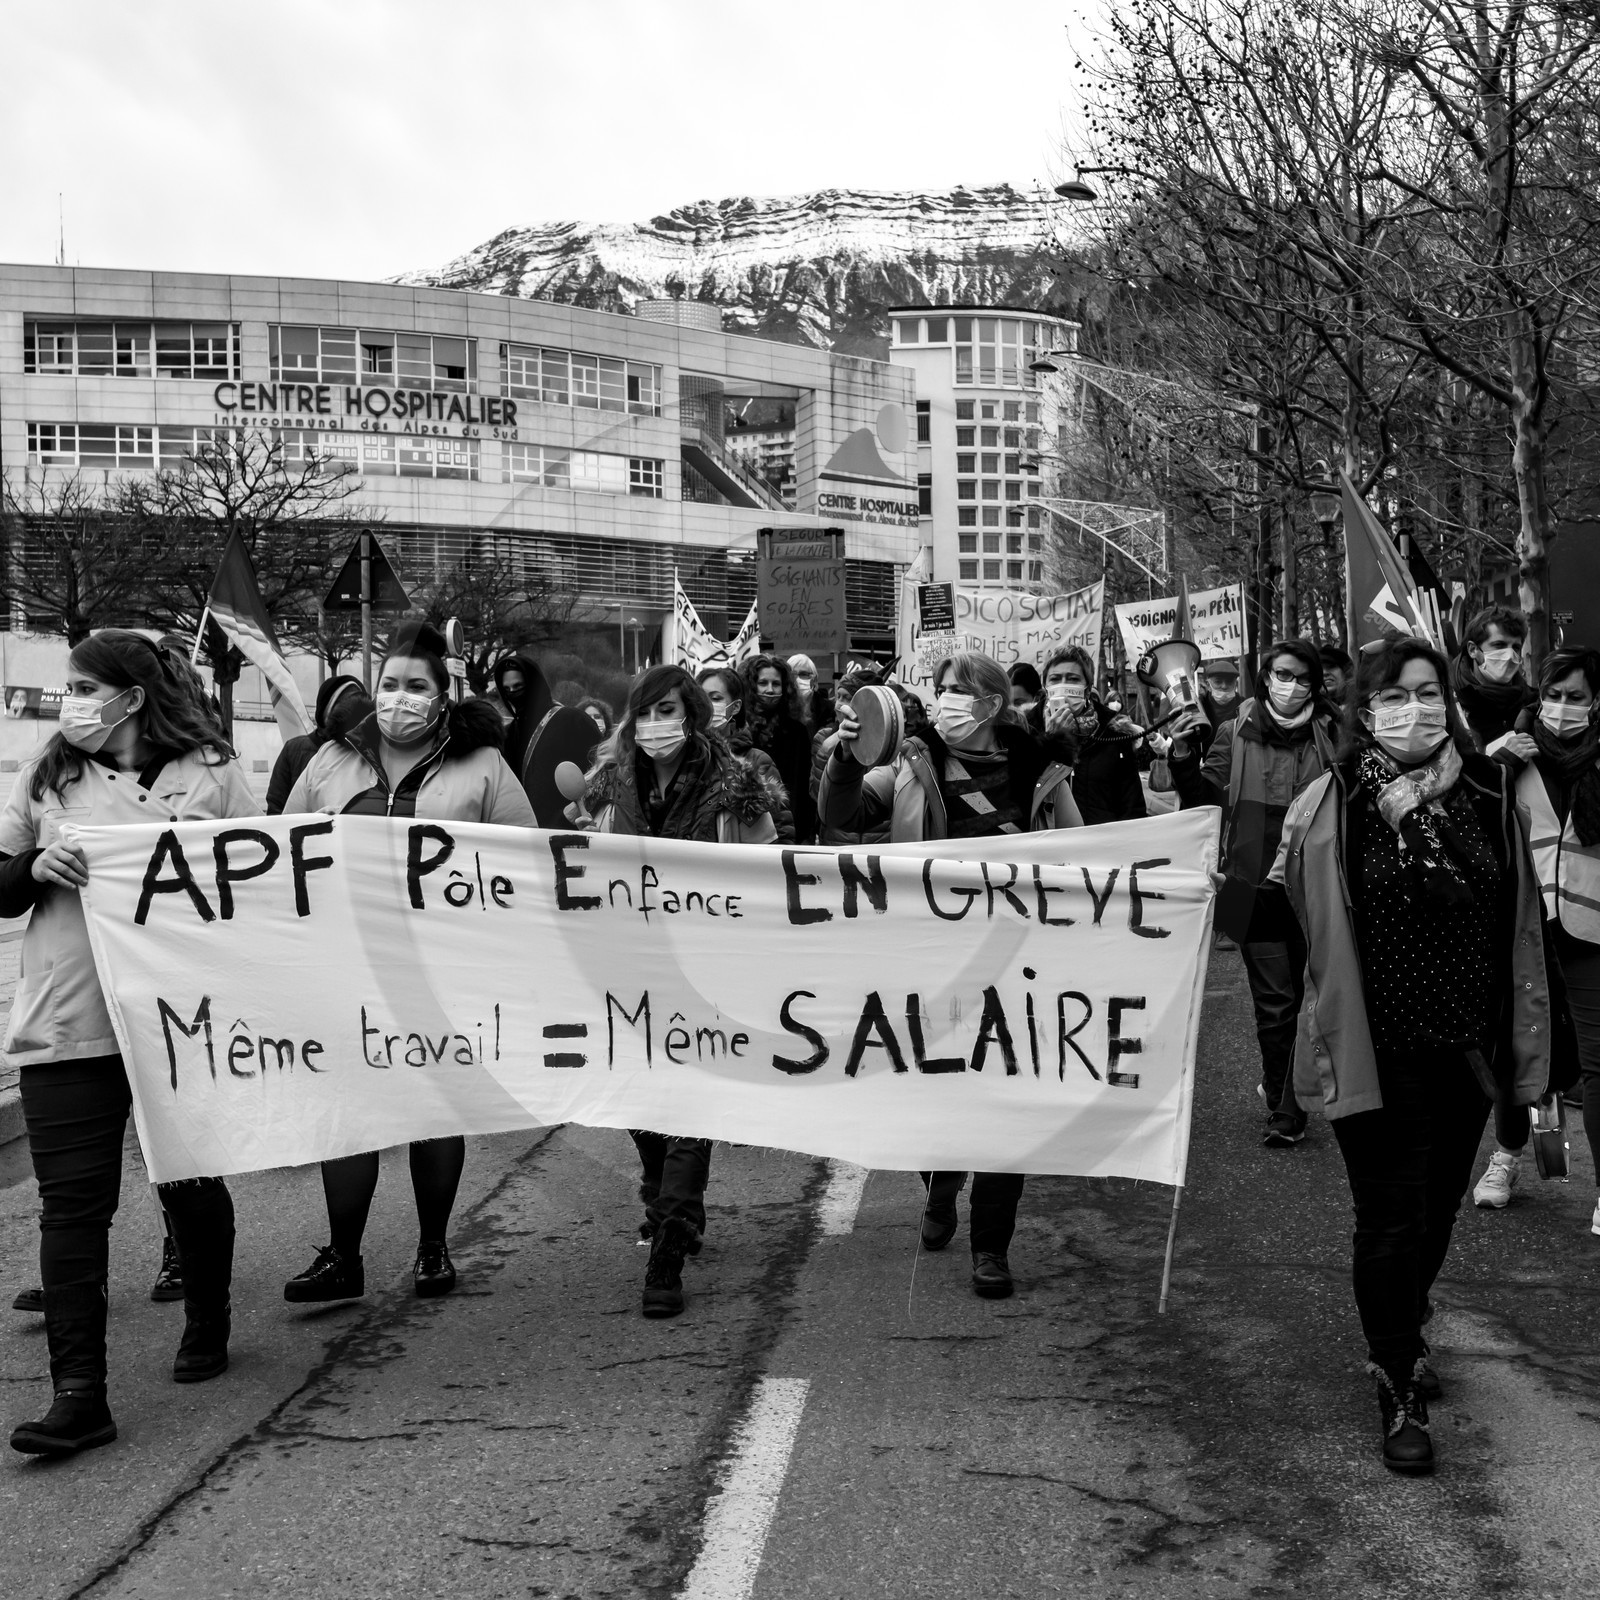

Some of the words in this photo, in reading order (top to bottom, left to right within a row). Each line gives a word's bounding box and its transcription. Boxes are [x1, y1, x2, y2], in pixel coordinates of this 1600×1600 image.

[214, 382, 331, 413] CENTRE
[346, 387, 518, 426] HOSPITALIER
[214, 413, 343, 430] Intercommunal
[361, 417, 388, 431] des
[404, 421, 448, 436] Alpes
[462, 425, 480, 437] du
[493, 427, 519, 440] Sud
[818, 493, 857, 511] CENTRE
[860, 498, 919, 517] HOSPITALIER
[767, 598, 834, 616] SOLDES
[791, 587, 812, 602] EN
[1019, 588, 1101, 622] SOCIAL
[1026, 627, 1062, 645] MAS
[134, 819, 334, 926] APF
[406, 824, 515, 911] Pôle
[547, 832, 744, 924] Enfance
[782, 849, 888, 925] EN
[157, 993, 325, 1097] Même
[361, 1003, 500, 1070] travail
[606, 989, 750, 1071] Même
